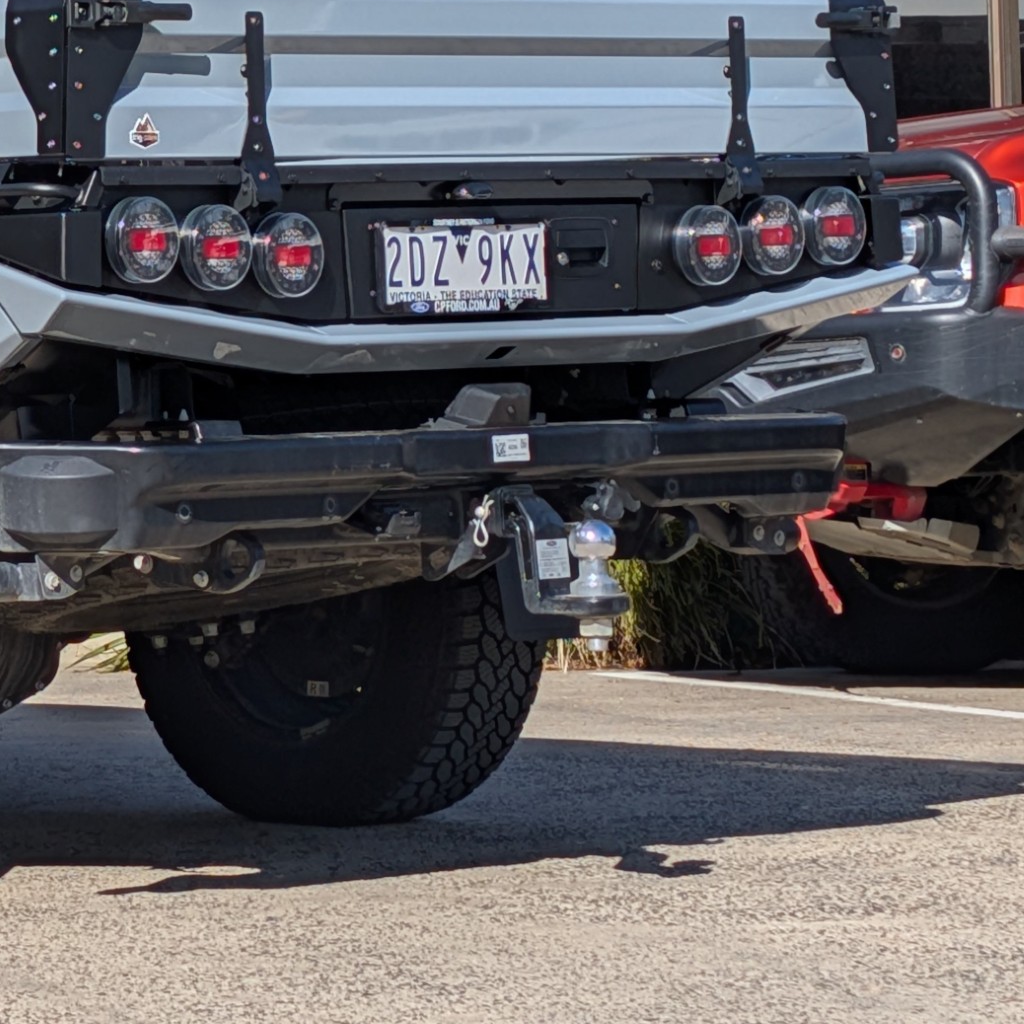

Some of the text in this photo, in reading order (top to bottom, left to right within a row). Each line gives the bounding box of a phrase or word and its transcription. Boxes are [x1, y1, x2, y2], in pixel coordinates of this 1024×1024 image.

[454, 234, 471, 246] VIC
[386, 233, 541, 288] 2DZ 9KX
[389, 291, 431, 303] VICTORIA
[440, 290, 458, 301] THE
[460, 289, 509, 300] EDUCATION
